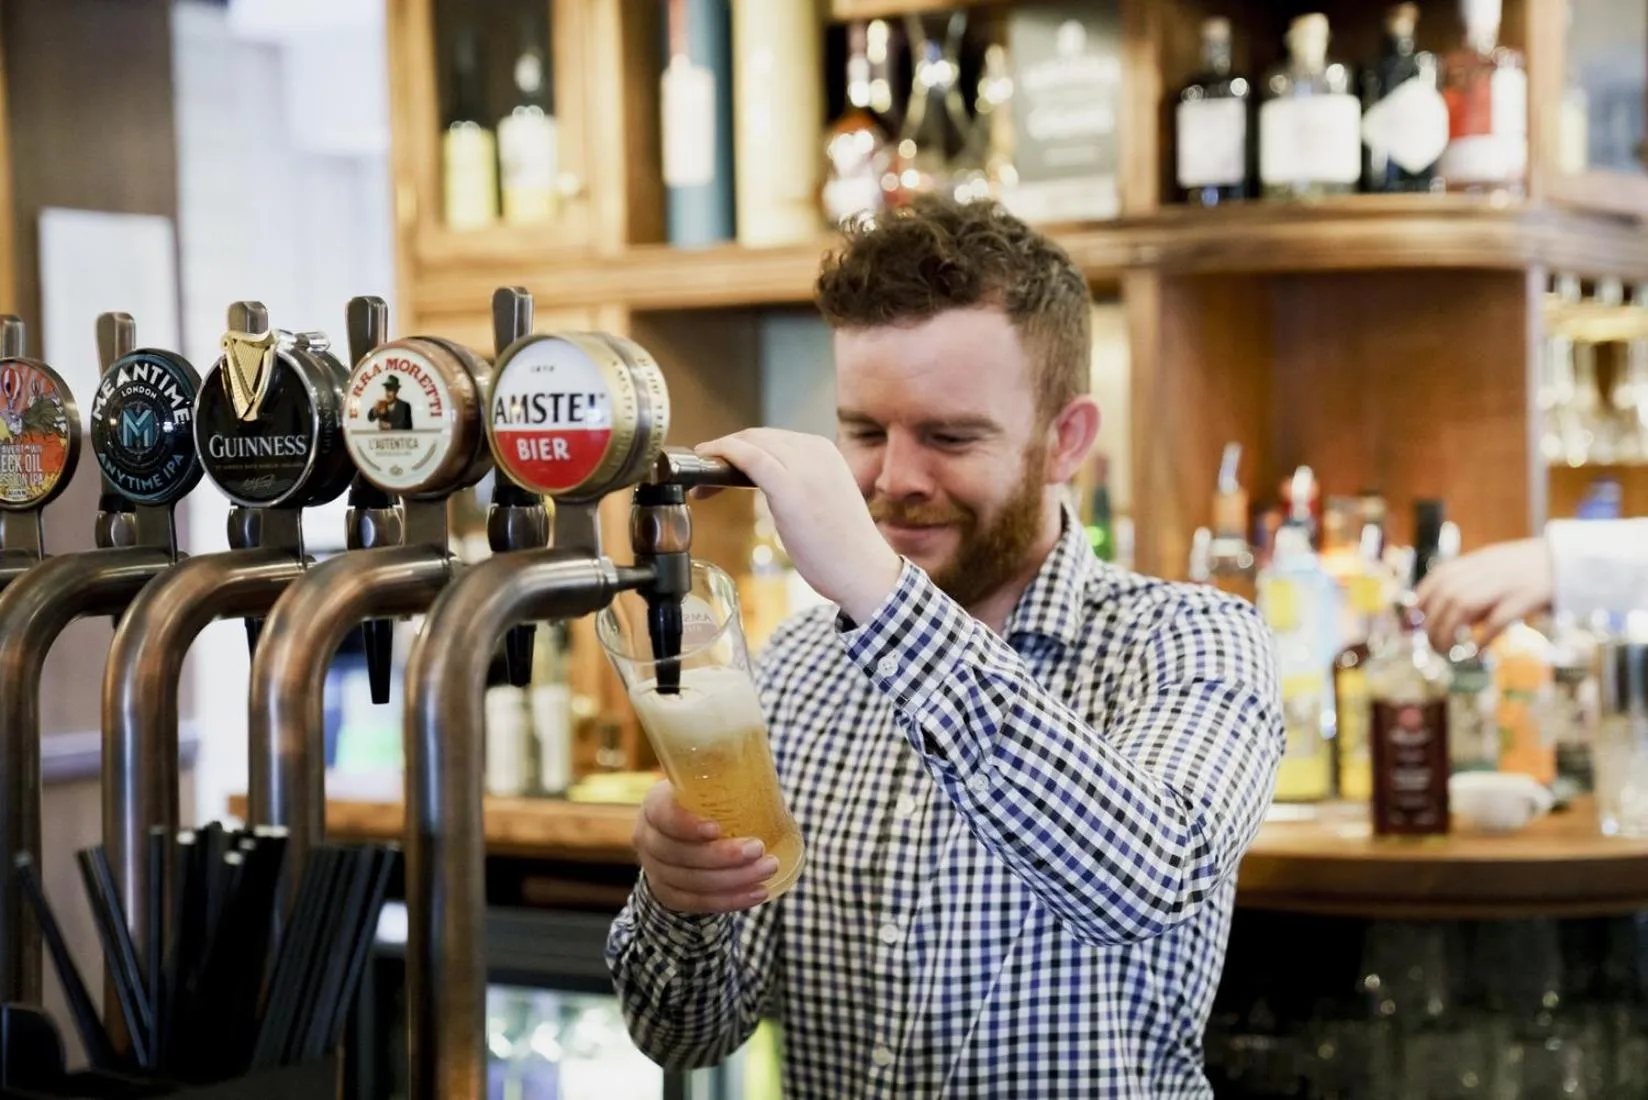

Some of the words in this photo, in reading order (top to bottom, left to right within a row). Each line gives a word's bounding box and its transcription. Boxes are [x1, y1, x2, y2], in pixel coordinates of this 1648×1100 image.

[92, 362, 190, 425] MEANTIME
[121, 385, 157, 399] LONDON
[349, 363, 382, 419] BRRA
[385, 358, 442, 417] MORETTI
[209, 434, 307, 458] GUINNESS
[516, 437, 571, 461] BIER
[1, 454, 22, 472] ECK
[24, 454, 43, 472] OIL
[98, 453, 163, 491] ANYTIME
[163, 454, 184, 479] IPA
